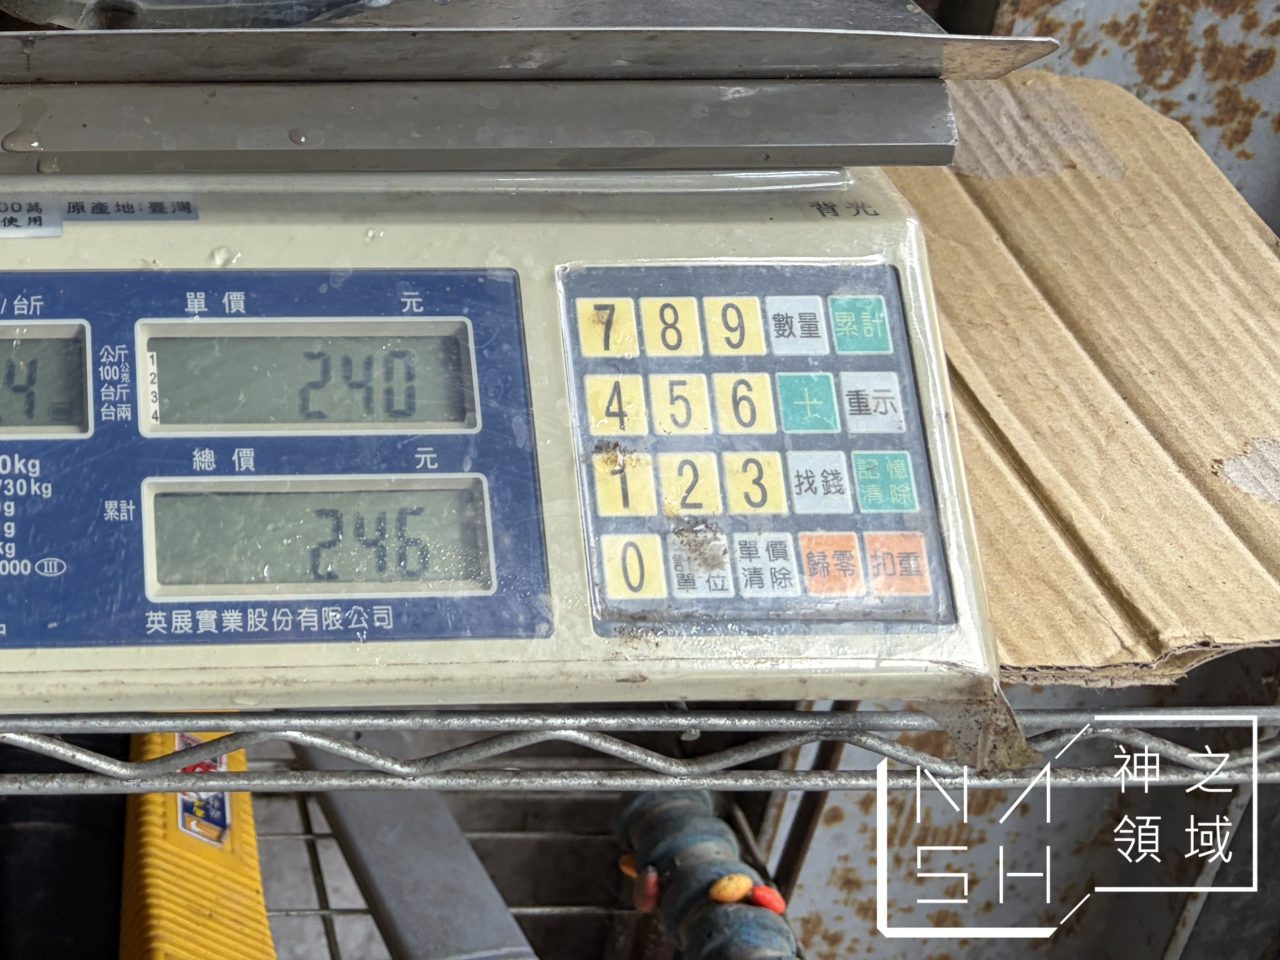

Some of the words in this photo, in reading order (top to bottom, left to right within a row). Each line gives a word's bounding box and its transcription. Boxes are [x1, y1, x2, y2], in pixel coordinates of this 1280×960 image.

[809, 201, 880, 217] 背光
[184, 291, 246, 314] 單價
[400, 292, 424, 314] 元
[593, 304, 616, 352] 7
[659, 302, 683, 351] 8
[721, 302, 747, 350] 9
[771, 311, 822, 339] 數量
[834, 311, 883, 338] 累計
[99, 344, 129, 363] 公斤
[149, 353, 156, 366] 1
[149, 372, 157, 385] 2
[298, 350, 416, 420] 240
[100, 383, 131, 402] 台斤
[150, 390, 158, 404] 3
[604, 380, 627, 431] 4
[669, 379, 693, 429] 5
[731, 379, 757, 429] 6
[845, 389, 898, 416] 重示
[100, 402, 132, 421] 台兩
[151, 409, 160, 422] 4
[192, 448, 256, 472] 總價
[414, 448, 439, 470] 元
[856, 459, 909, 481] 記憶
[612, 462, 630, 509] 1
[677, 459, 703, 510] 2
[742, 457, 768, 509] 3
[794, 469, 845, 496] 找錢
[860, 484, 913, 505] 清除
[103, 499, 136, 522] 累計
[310, 506, 430, 580] 246
[737, 539, 790, 563] 單價
[621, 540, 646, 593] 0
[806, 550, 857, 578] 歸零
[870, 551, 923, 577] 扣重
[676, 574, 729, 592] 單位
[742, 566, 795, 590] 清除
[145, 605, 395, 635] 英展實業股份有限公司
